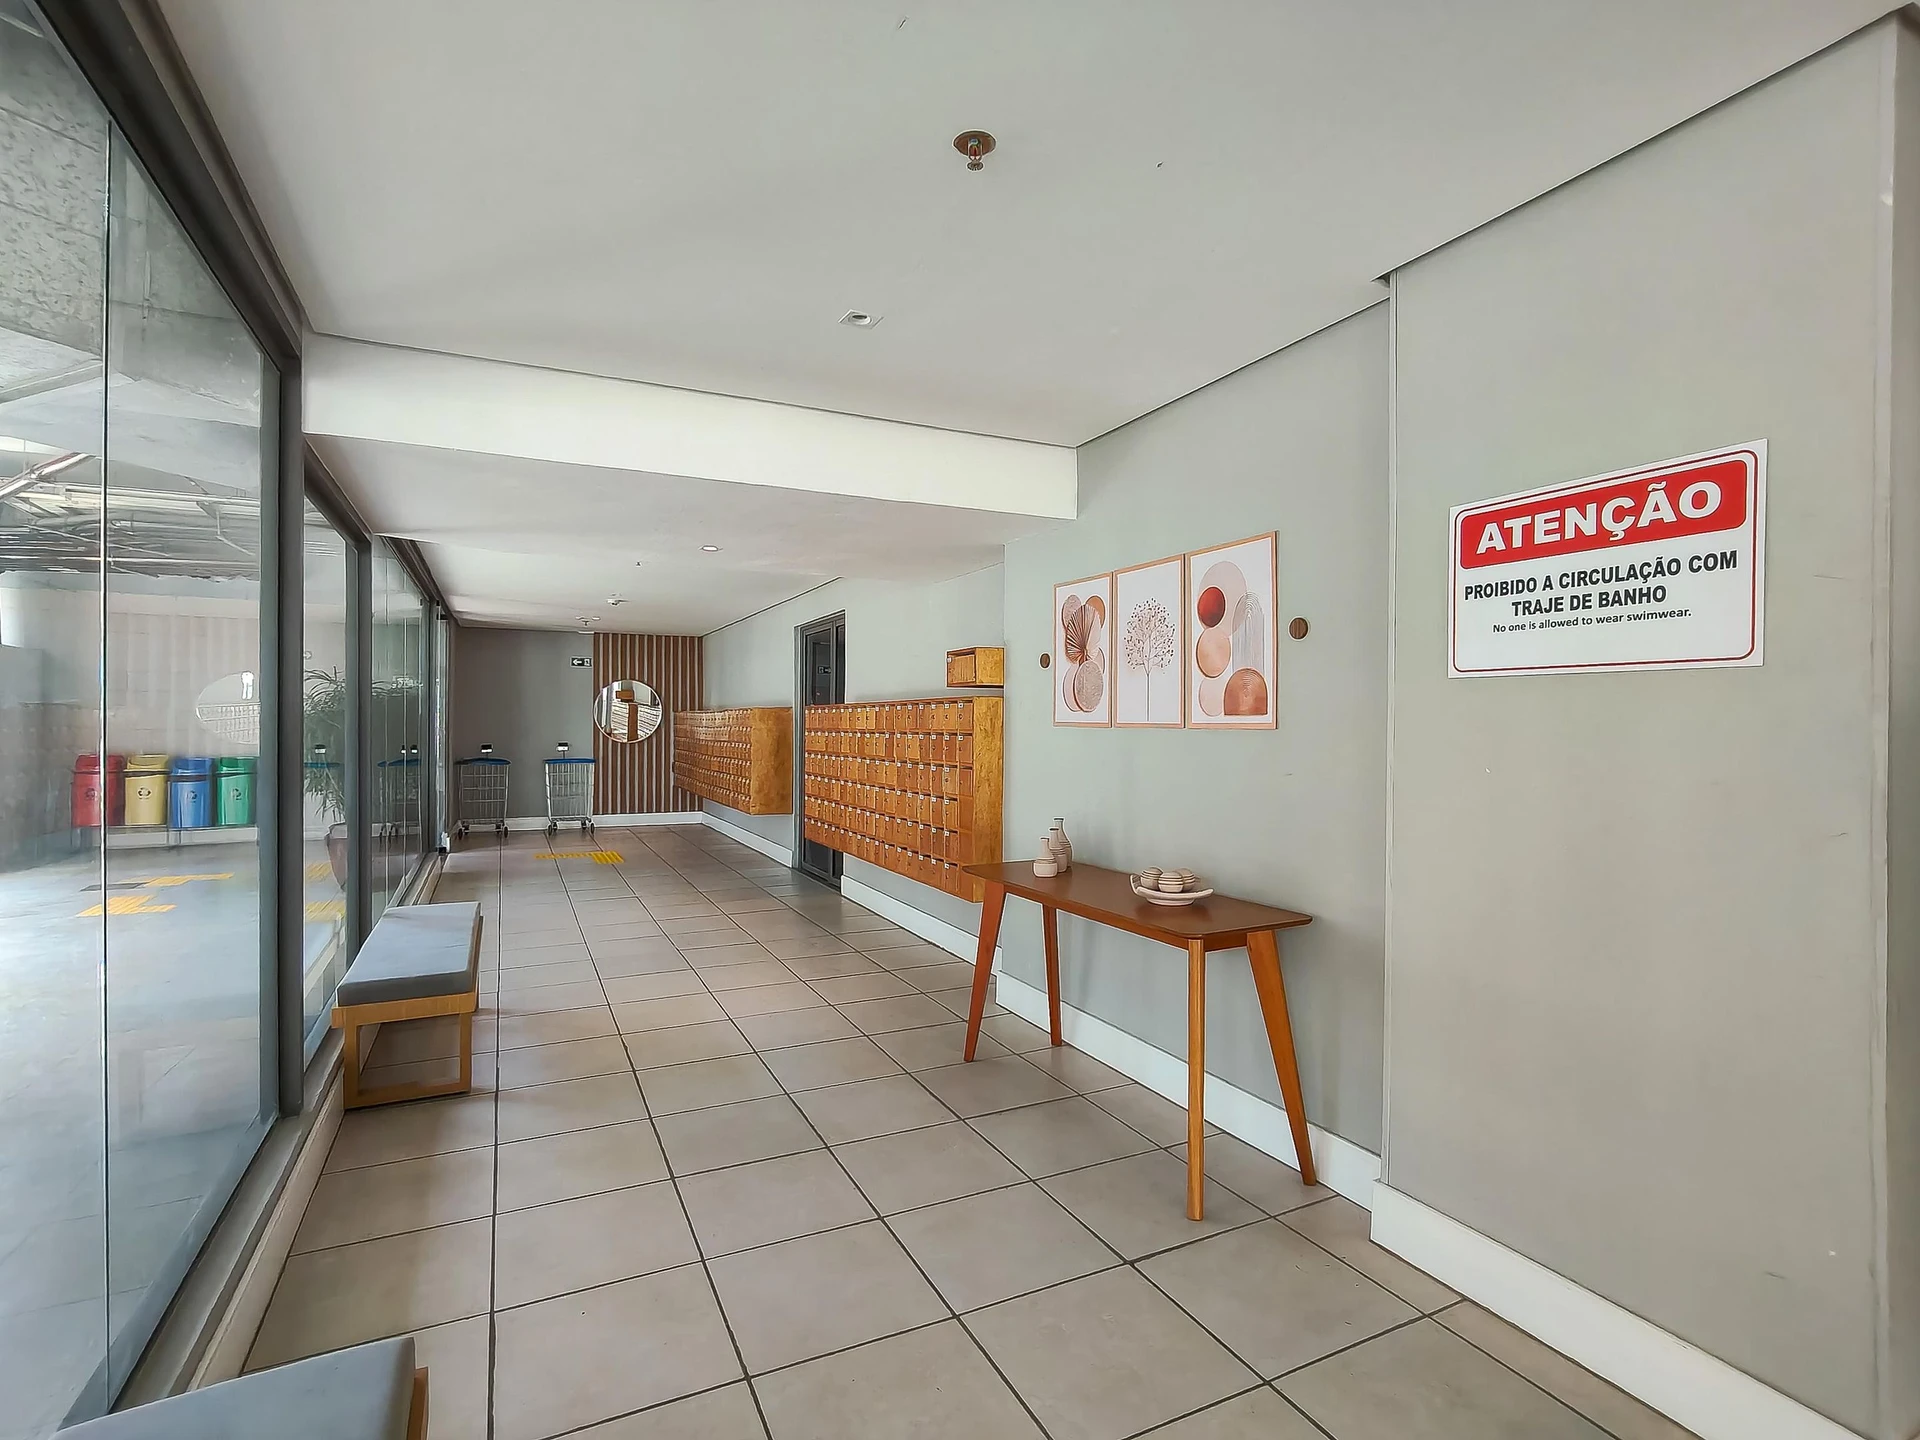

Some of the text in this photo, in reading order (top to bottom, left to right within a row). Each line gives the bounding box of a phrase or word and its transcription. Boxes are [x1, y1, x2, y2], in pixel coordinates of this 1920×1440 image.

[1476, 481, 1722, 554] ATENÇÃO
[1464, 550, 1737, 600] PROIBIDO A CIRCULAÇÃO COM
[1493, 608, 1692, 633] No one is allowed to wear swimwear.
[1512, 585, 1667, 616] TRAJE DE BANHO
